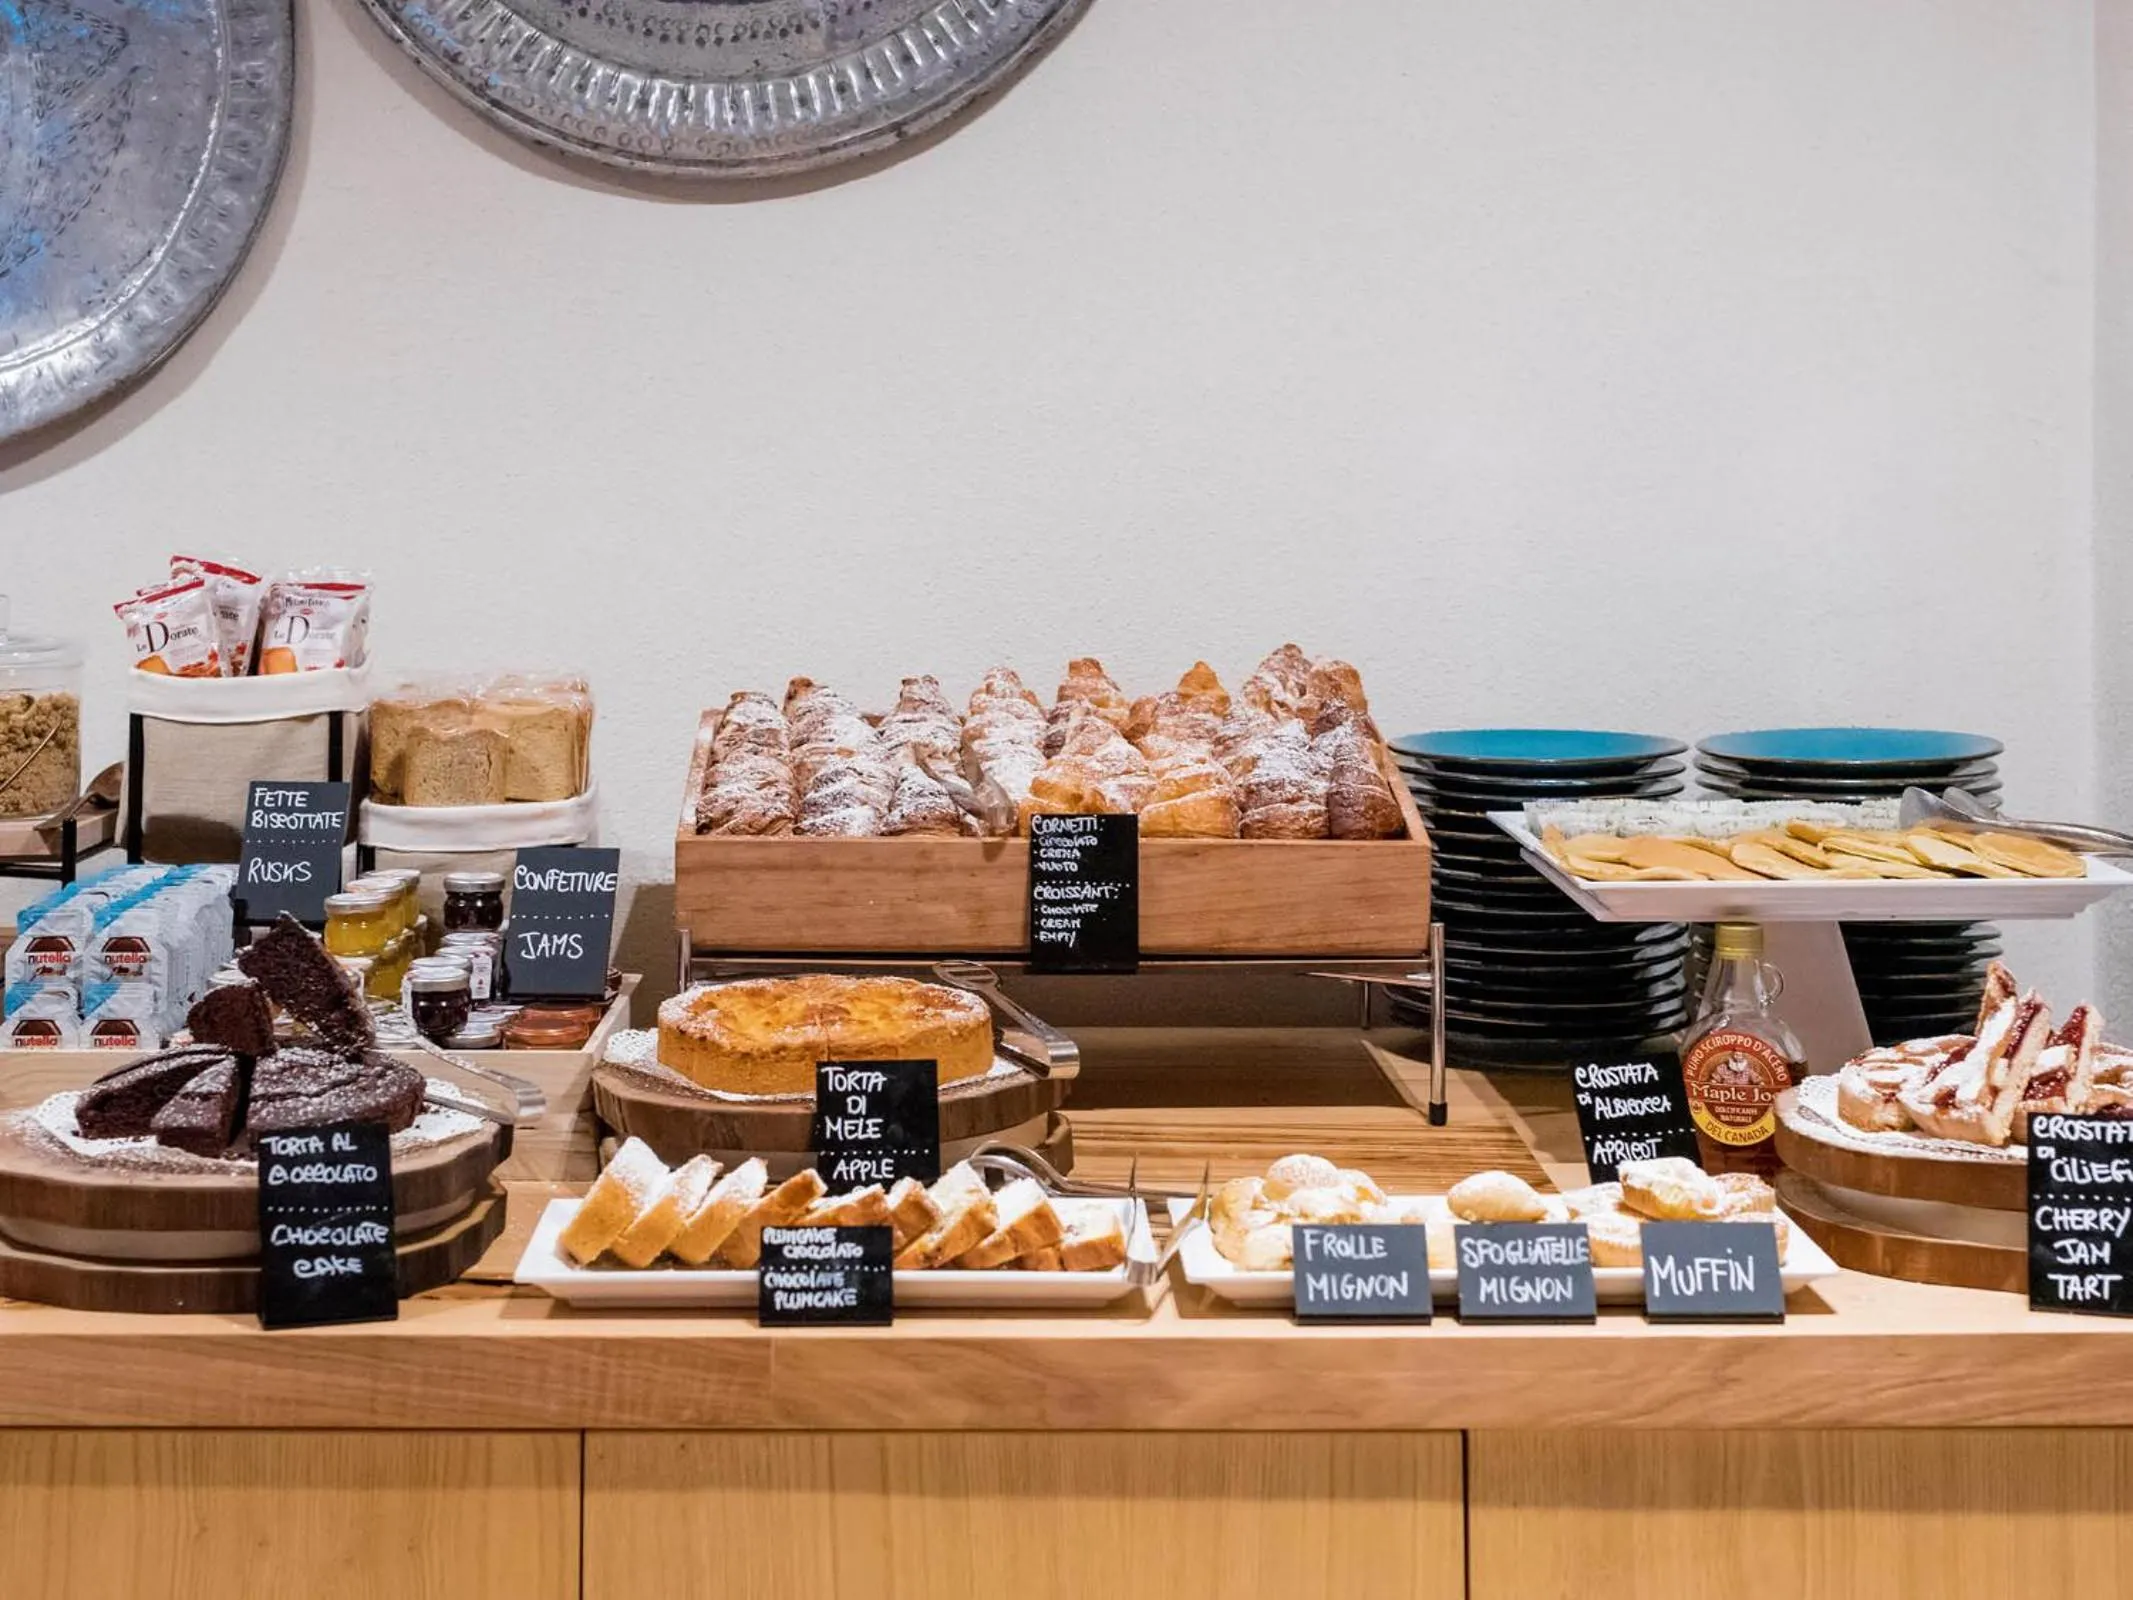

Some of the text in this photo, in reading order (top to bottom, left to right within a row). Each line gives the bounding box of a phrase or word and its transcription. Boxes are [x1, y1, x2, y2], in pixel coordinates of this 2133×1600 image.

[143, 621, 201, 653] Dorate
[255, 787, 310, 808] FETTE
[251, 809, 345, 830] BISCOTTATE
[1038, 861, 1079, 872] VUOTO
[1039, 848, 1081, 860] CREMA
[248, 857, 313, 884] RUSKS
[514, 864, 619, 893] CONFETTURE
[518, 932, 584, 960] JAMS
[1039, 931, 1076, 949] EMPTY
[28, 952, 71, 964] nutella
[105, 952, 147, 964] nutella
[14, 1035, 58, 1046] nutella
[94, 1035, 137, 1046] nutella
[1686, 1034, 1788, 1082] PURO SCIROPPO D'ACERO
[821, 1066, 888, 1092] TORTA
[1574, 1062, 1660, 1089] CROSTATA
[846, 1094, 867, 1115] DI
[1691, 1081, 1776, 1103] Maple Jo
[824, 1115, 884, 1140] MELE
[1705, 1120, 1770, 1143] DEL CANADA
[260, 1132, 358, 1157] TORTA AL
[1593, 1138, 1663, 1165] APRICOT
[832, 1158, 895, 1181] APPLE
[270, 1221, 389, 1246] CHOCOLATE
[2035, 1206, 2131, 1238] CHERRY
[763, 1226, 837, 1245] PLUMCAKE
[1303, 1228, 1388, 1262] FROLLE
[2053, 1238, 2112, 1265] JAM
[293, 1255, 363, 1278] CAKE
[1305, 1270, 1409, 1302] MIGNON
[1479, 1274, 1574, 1305] MIGNON
[2047, 1273, 2123, 1301] TART
[774, 1287, 859, 1311] PLUMCAKE
